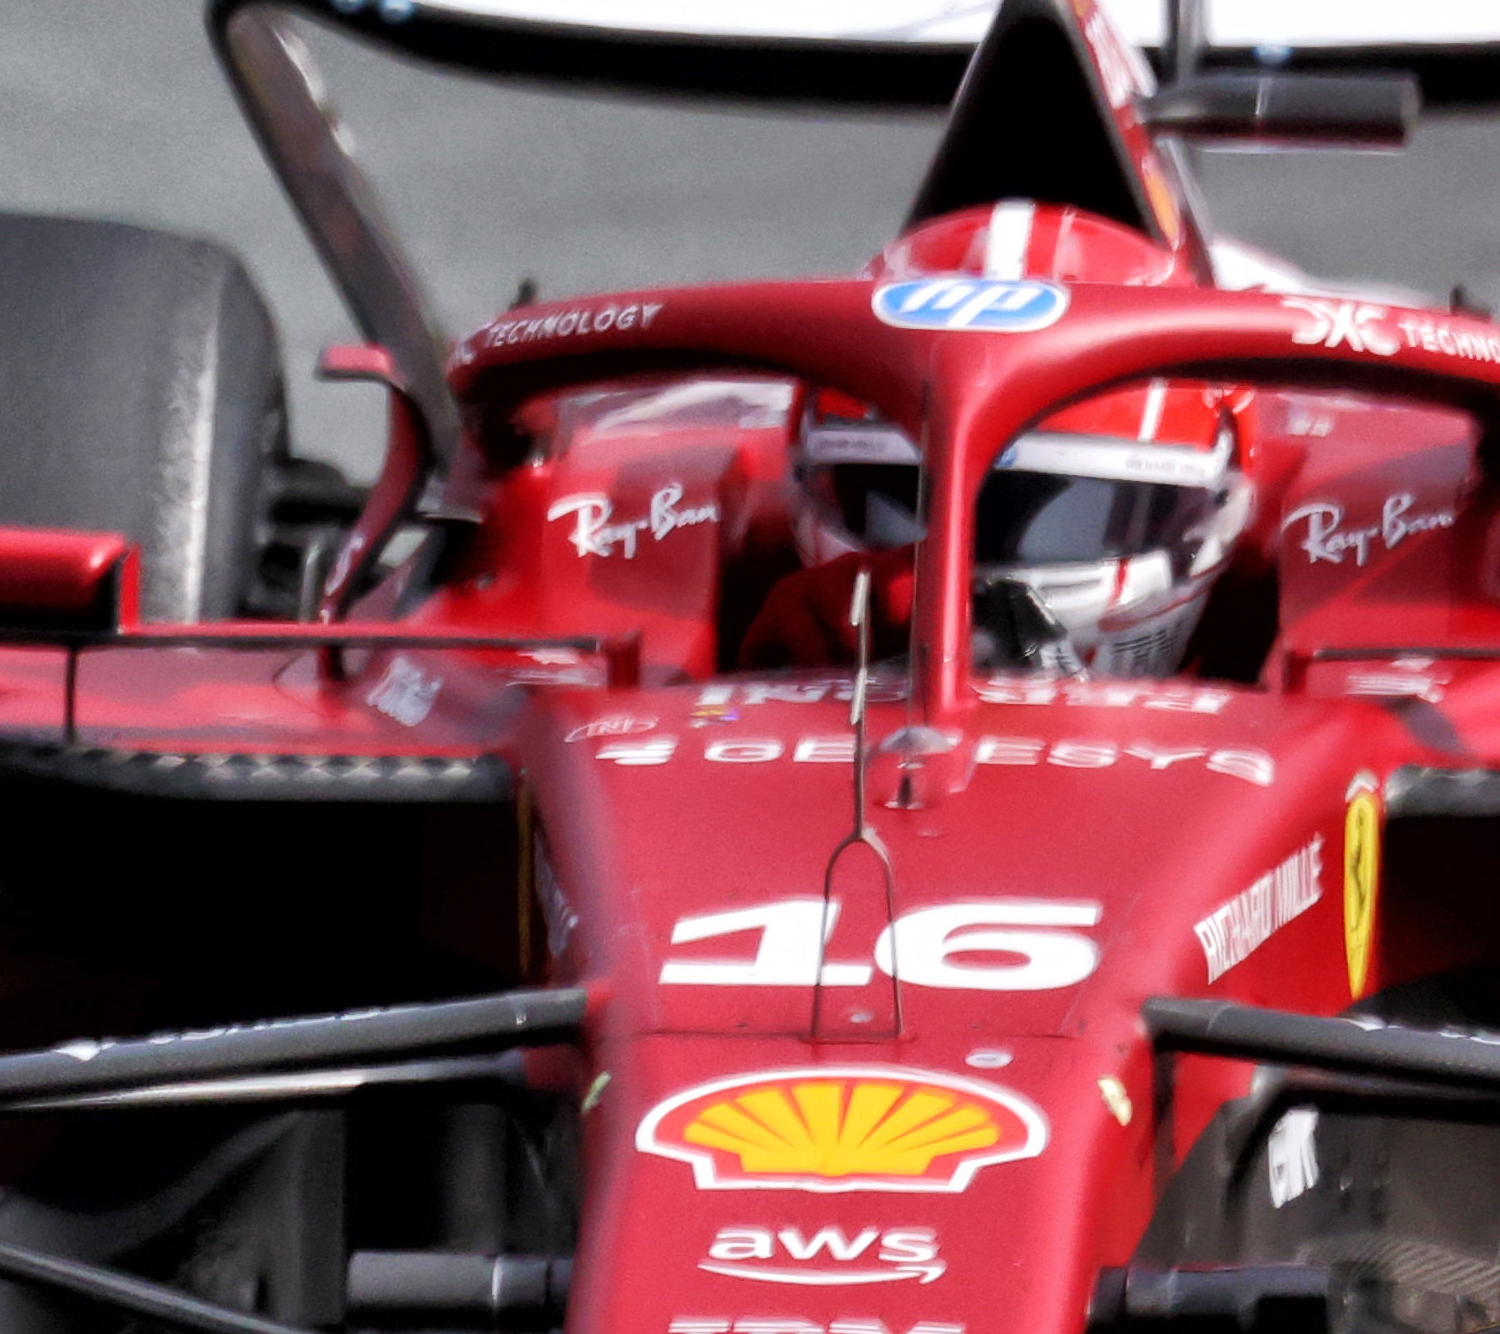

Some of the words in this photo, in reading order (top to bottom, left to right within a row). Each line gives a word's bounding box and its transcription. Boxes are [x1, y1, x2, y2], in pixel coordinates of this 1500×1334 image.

[484, 304, 662, 347] TECHNOLOGY
[901, 281, 1048, 326] hp
[548, 482, 720, 558] Ray-Ban
[1280, 493, 1454, 567] Ray-Ban
[704, 734, 1275, 787] GEESYS
[659, 897, 1102, 989] 16
[709, 1225, 940, 1263] aws
